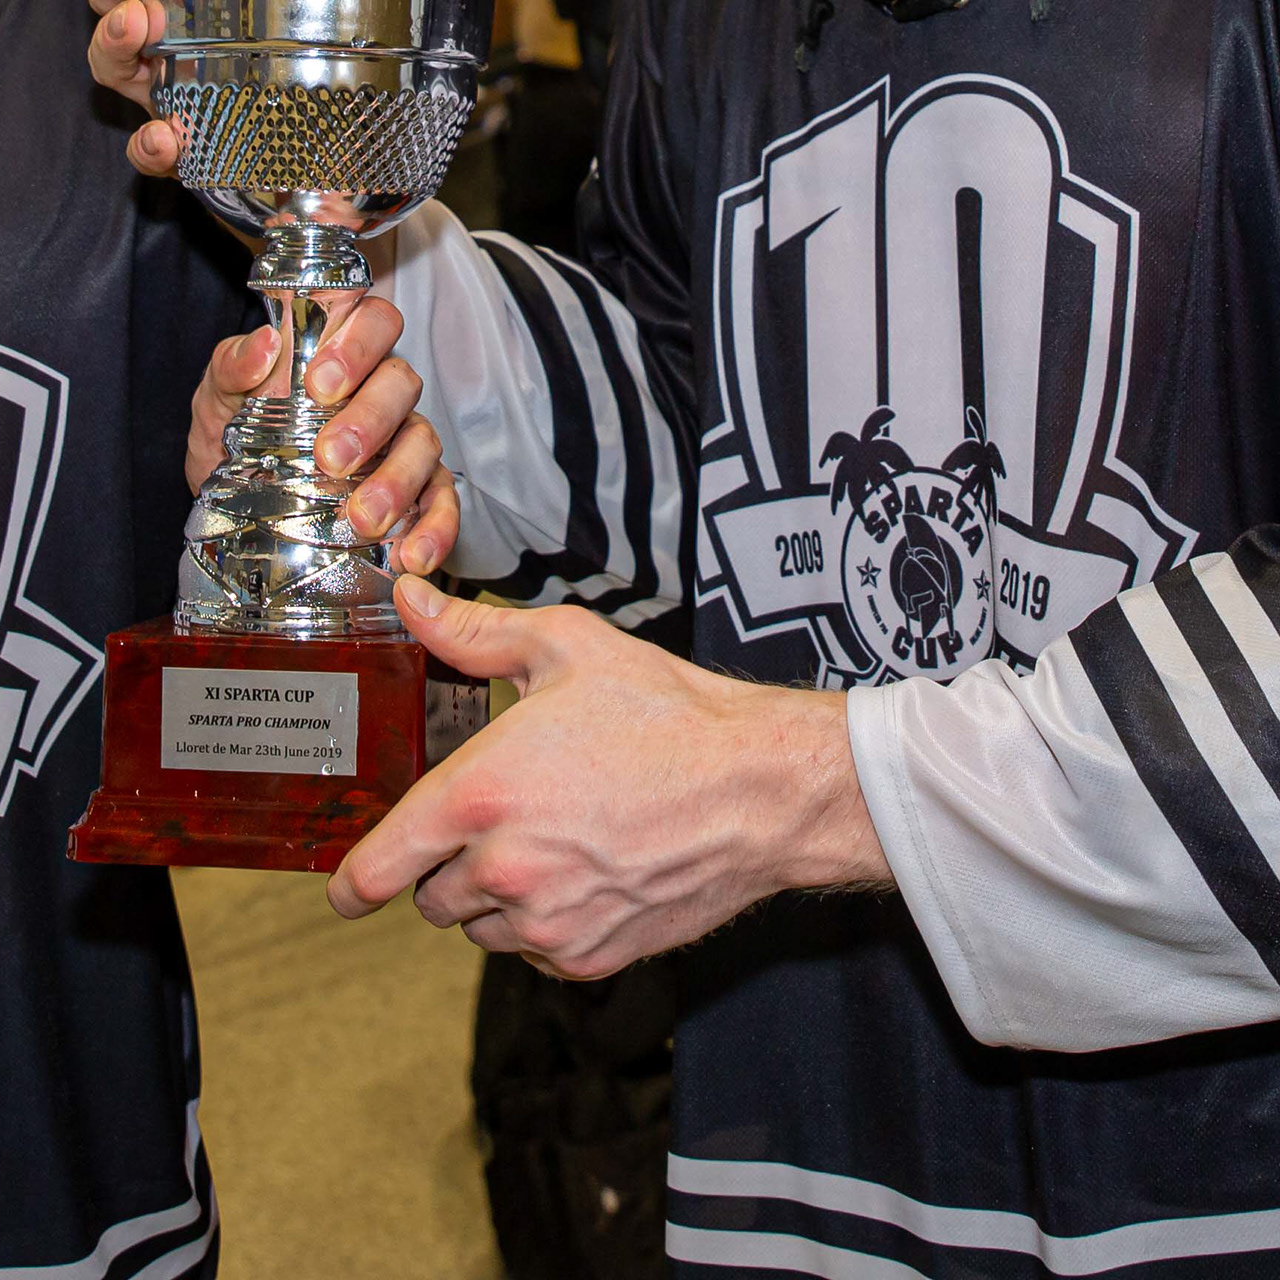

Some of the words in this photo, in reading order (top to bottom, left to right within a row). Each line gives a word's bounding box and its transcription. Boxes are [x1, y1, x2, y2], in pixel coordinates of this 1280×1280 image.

[767, 93, 1054, 526] 10
[864, 484, 984, 558] SPARTA
[775, 530, 825, 578] 2009
[999, 557, 1051, 621] 2019
[890, 625, 965, 669] CUP
[204, 686, 222, 702] XI
[223, 687, 281, 703] SPARTA
[283, 689, 315, 704] CUP
[187, 714, 234, 728] SPARTA
[235, 715, 262, 728] PRO
[264, 716, 331, 731] CHAMPION
[175, 741, 210, 755] Lloret
[212, 742, 227, 756] de
[229, 743, 253, 757] Mar
[255, 744, 282, 758] 23th
[283, 745, 311, 760] June
[312, 746, 343, 760] 2019
